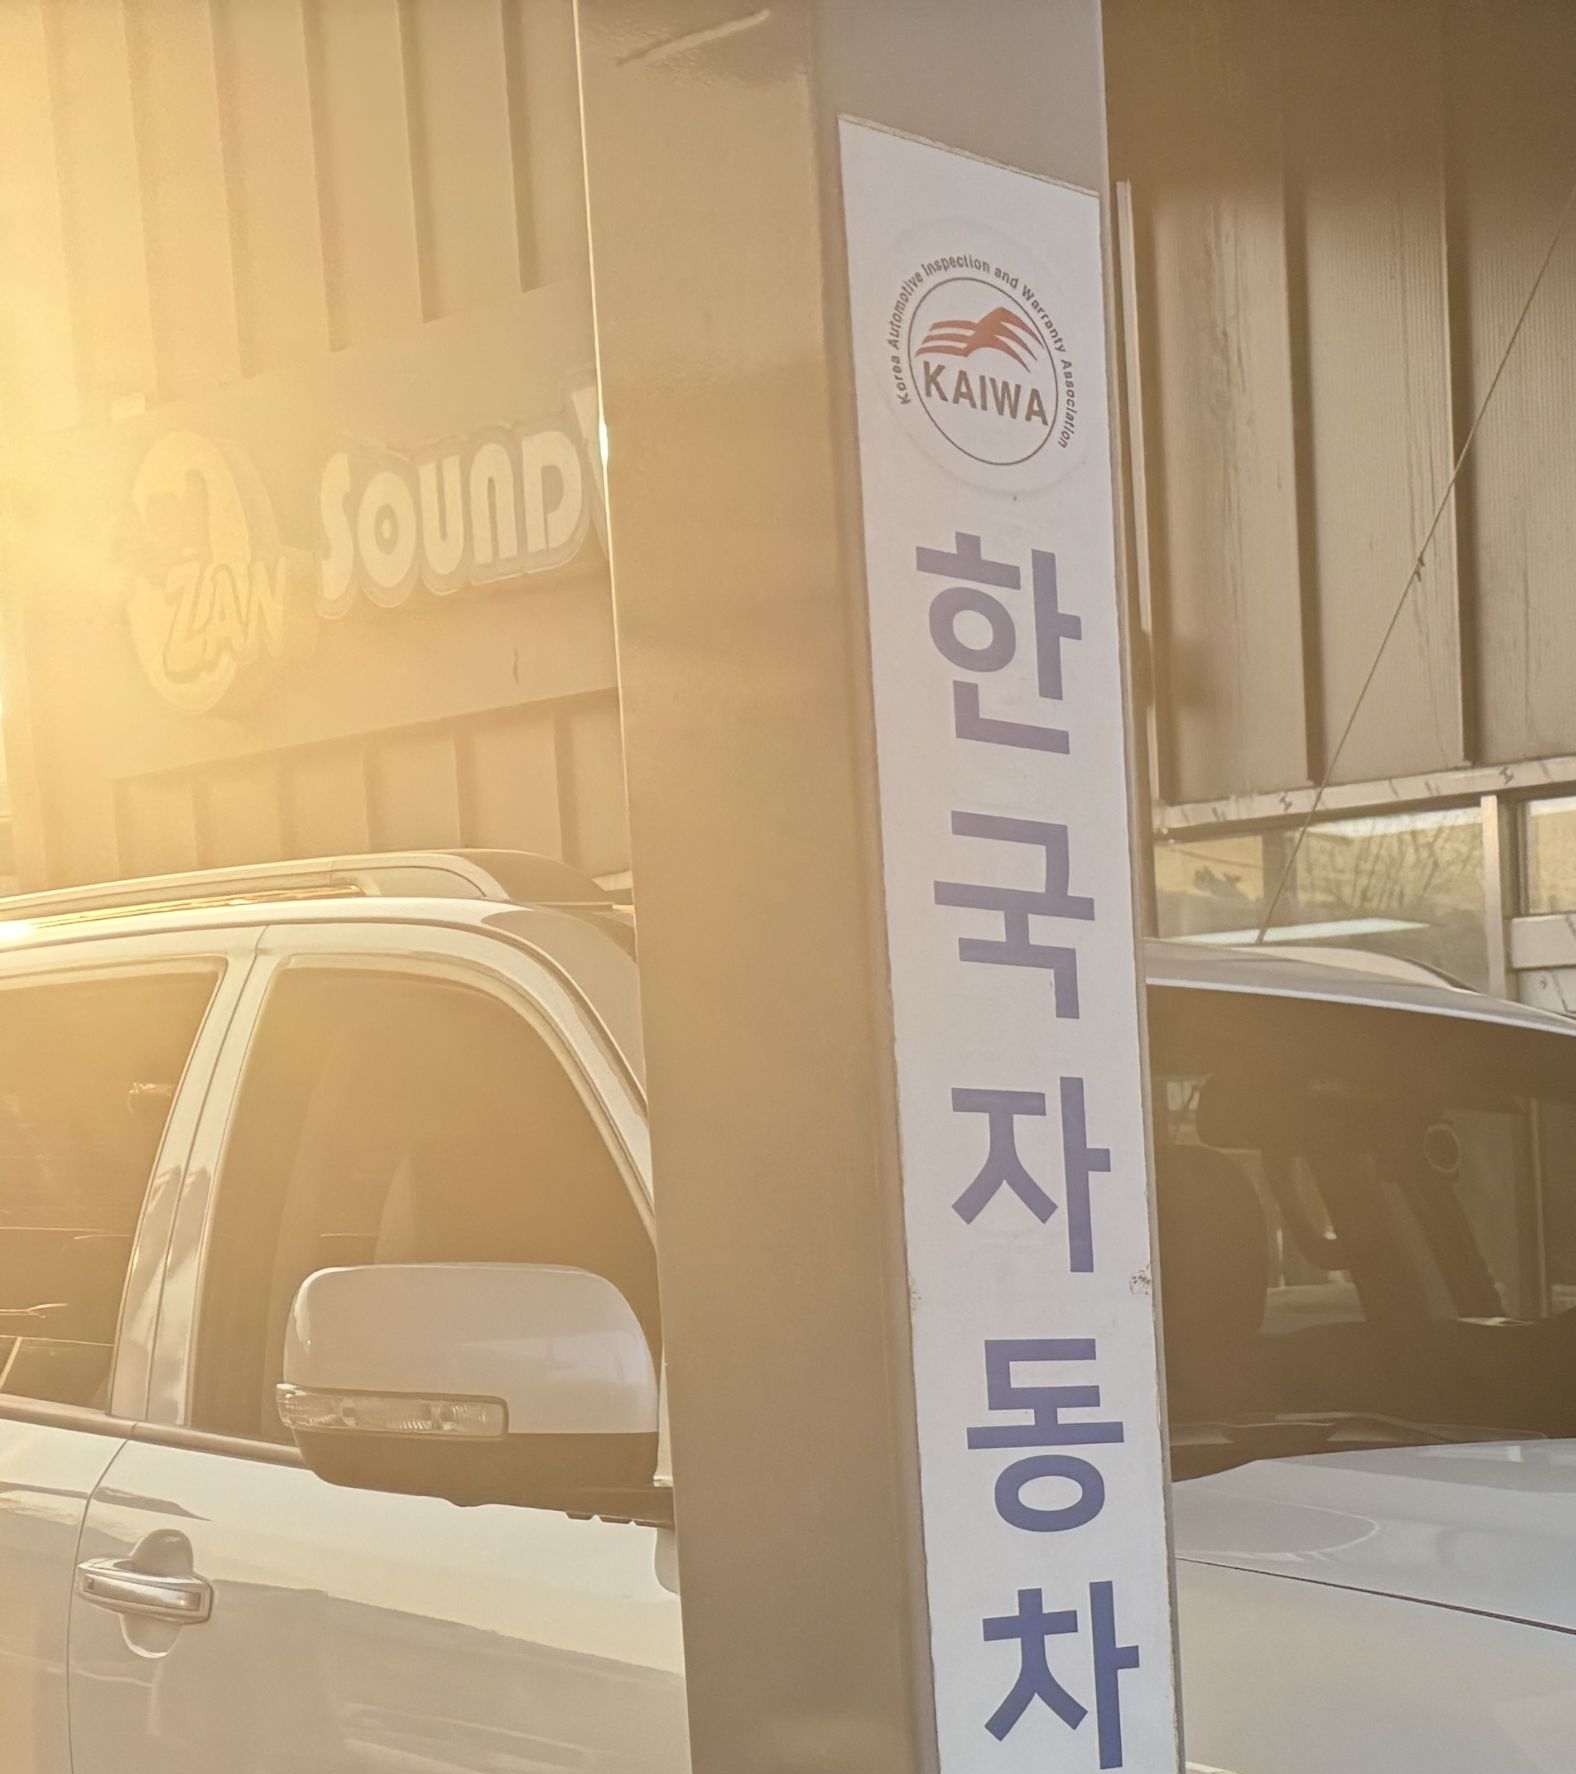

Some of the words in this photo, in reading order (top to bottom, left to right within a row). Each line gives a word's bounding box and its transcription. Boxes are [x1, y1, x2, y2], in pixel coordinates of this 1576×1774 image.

[887, 271, 924, 350] Automotive
[921, 254, 990, 279] Inspection
[993, 265, 1020, 290] and
[1021, 283, 1067, 353] Warranty
[1058, 358, 1079, 450] Association
[922, 360, 1049, 426] KAIWA
